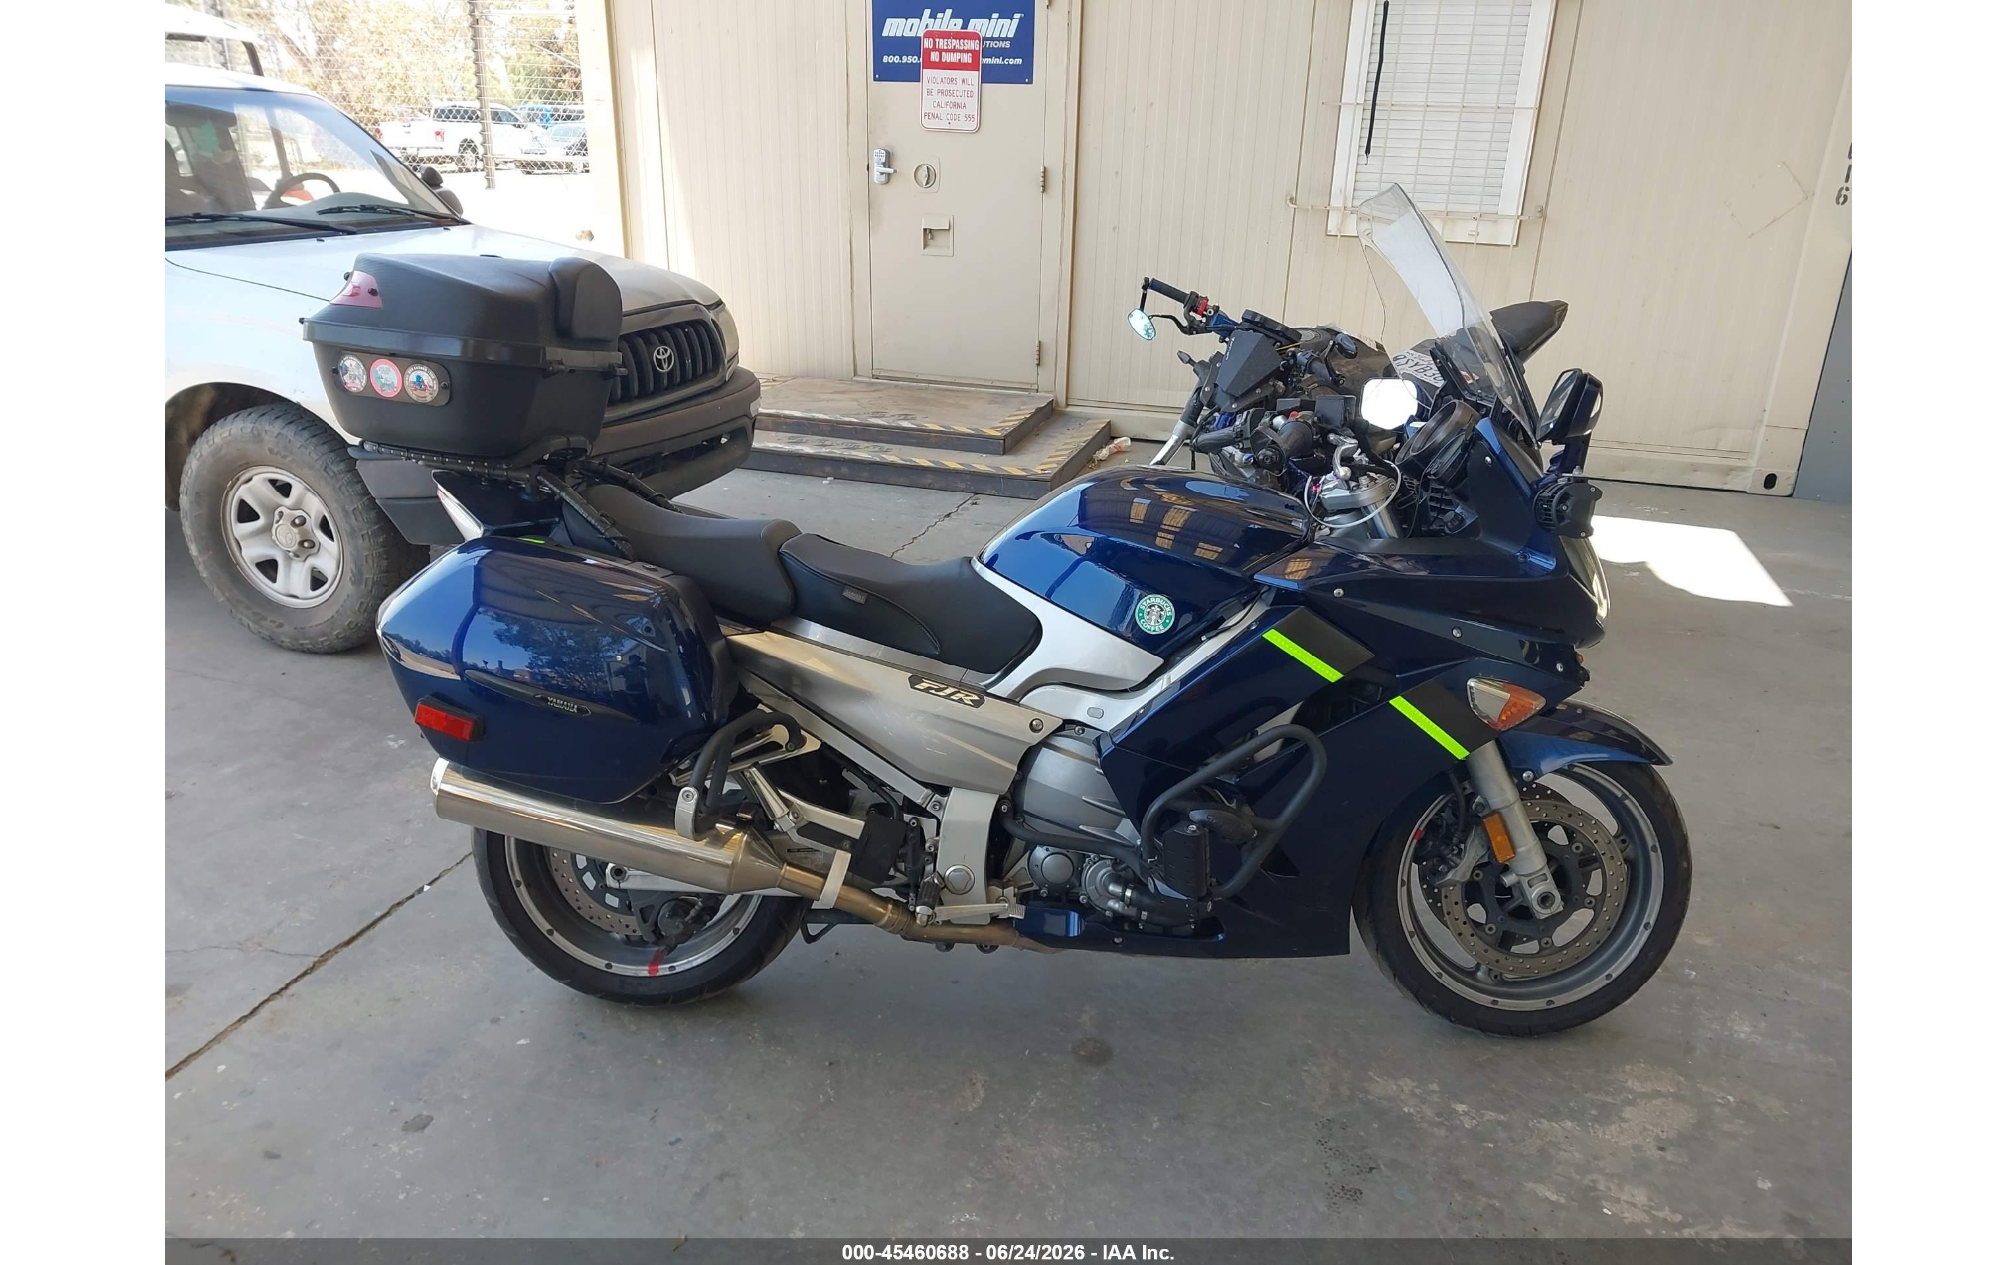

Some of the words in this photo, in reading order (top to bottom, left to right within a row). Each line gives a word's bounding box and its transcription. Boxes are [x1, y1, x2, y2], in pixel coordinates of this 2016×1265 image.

[881, 8, 963, 37] mobile
[967, 12, 1021, 38] mini
[923, 37, 933, 49] NO
[935, 38, 980, 51] TRESPASSING
[982, 40, 1011, 48] TIONS
[882, 55, 922, 64] 800.950.
[930, 50, 940, 62] NO
[941, 51, 973, 63] DUMPING
[982, 56, 1023, 65] mini.com
[926, 76, 958, 86] VIOLATORS
[961, 78, 975, 87] WILL
[926, 88, 934, 97] BE
[937, 88, 975, 98] PROSECUTED
[932, 100, 967, 110] CALIFORNIA
[923, 111, 943, 121] PENAL
[946, 112, 961, 122] CODE
[964, 113, 976, 123] 555
[1140, 597, 1172, 616] STARBUCKS
[1140, 619, 1165, 631] COFFEE
[913, 678, 981, 706] FJR
[547, 696, 578, 713] YAMAHA
